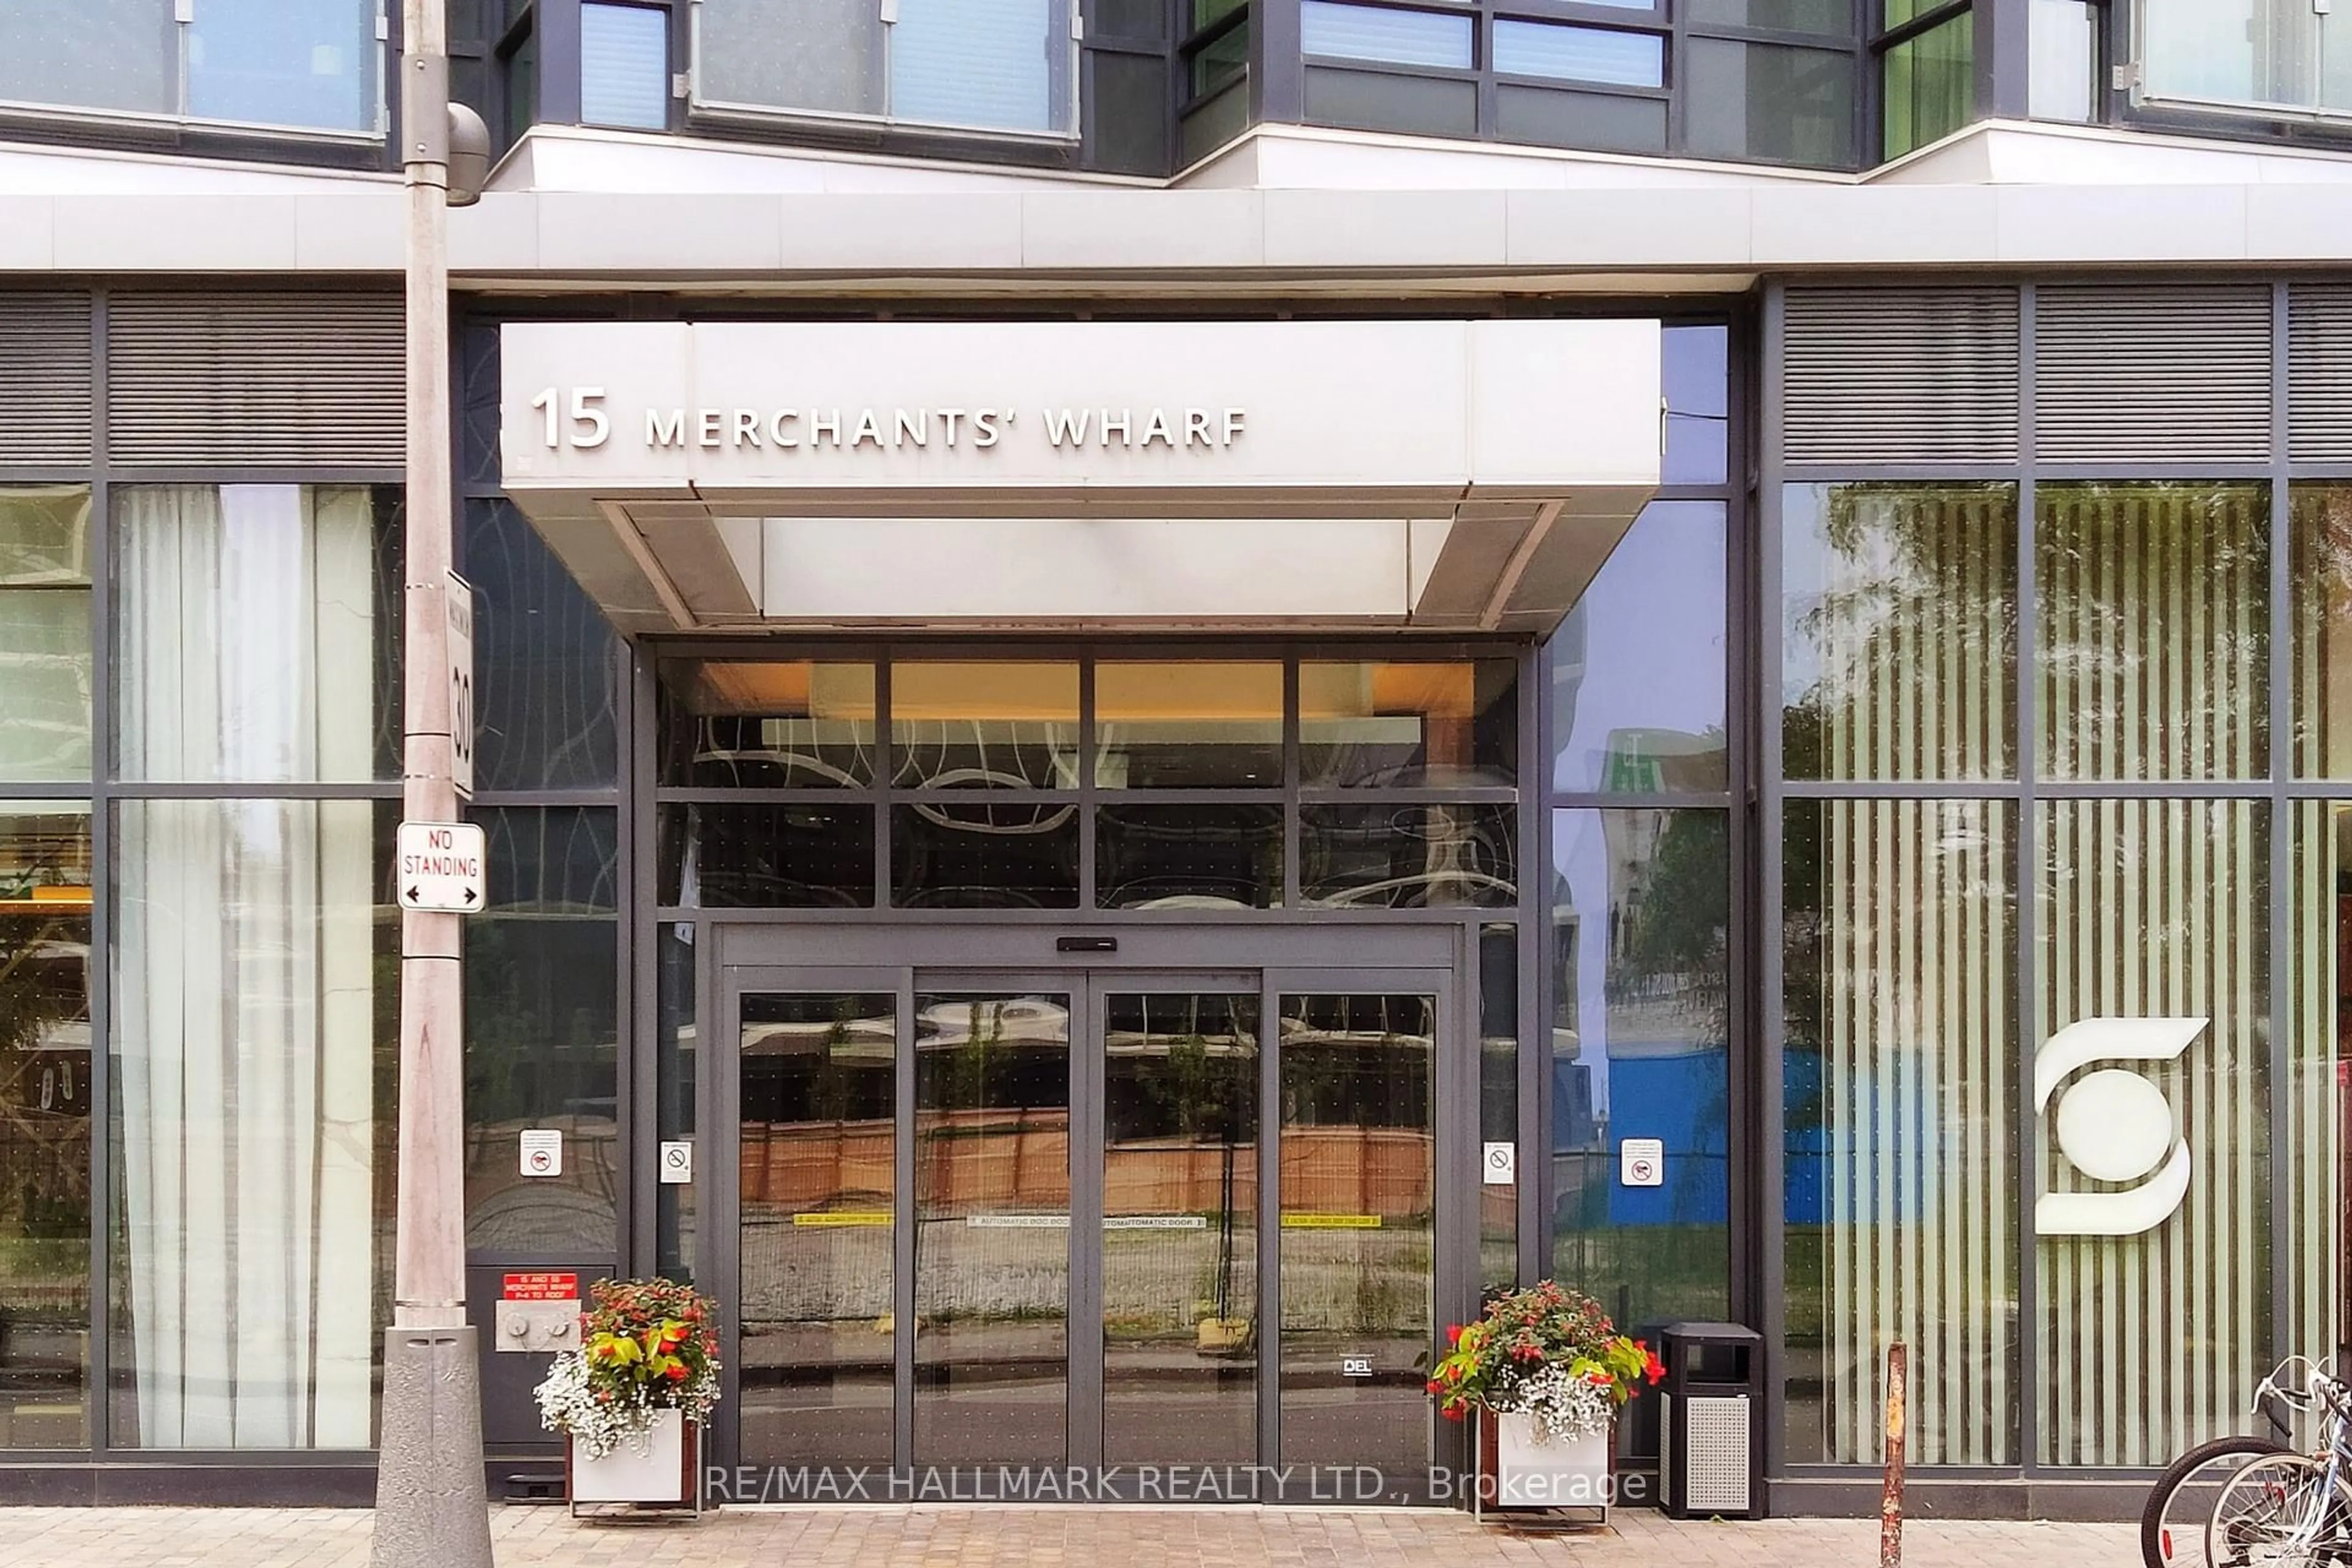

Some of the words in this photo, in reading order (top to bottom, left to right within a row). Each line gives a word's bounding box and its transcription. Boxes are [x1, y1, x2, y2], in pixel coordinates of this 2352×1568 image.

[530, 386, 612, 450] 15
[1042, 407, 1246, 448] WHARF
[429, 830, 453, 850] NO
[404, 855, 478, 877] STANDING
